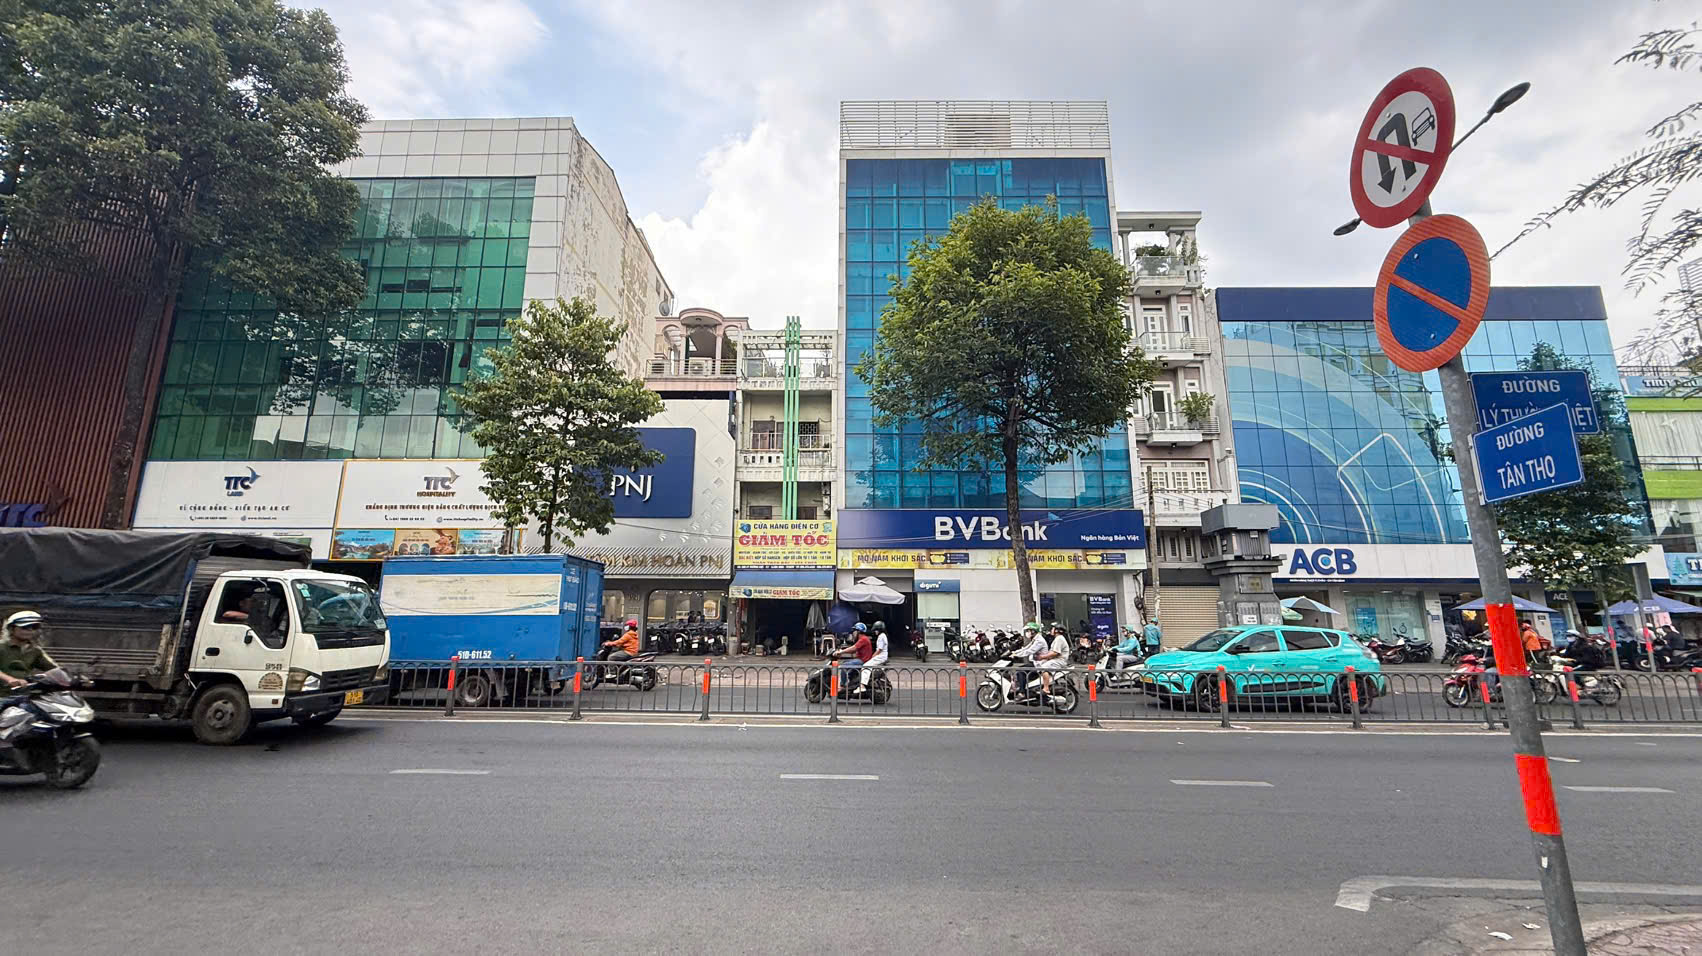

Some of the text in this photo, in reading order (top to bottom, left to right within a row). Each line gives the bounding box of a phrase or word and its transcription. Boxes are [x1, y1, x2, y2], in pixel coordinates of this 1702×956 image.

[1502, 376, 1560, 393] ĐƯỜNG
[1482, 403, 1499, 428] LÝ
[1571, 403, 1593, 431] IỆT
[1496, 422, 1545, 450] ĐƯỜNG
[1497, 455, 1556, 489] TÂN THỌ
[224, 476, 252, 490] TTC
[424, 476, 452, 490] TTC
[609, 474, 653, 502] PNJ
[753, 522, 768, 530] CỬA
[770, 521, 789, 530] HÀNG
[791, 522, 808, 531] ĐIỆN
[738, 531, 829, 546] GIẢM TỐC
[1098, 534, 1113, 542] hàng
[1127, 534, 1139, 542] Việt
[699, 555, 723, 569] PNJ
[1289, 548, 1357, 575] ACB
